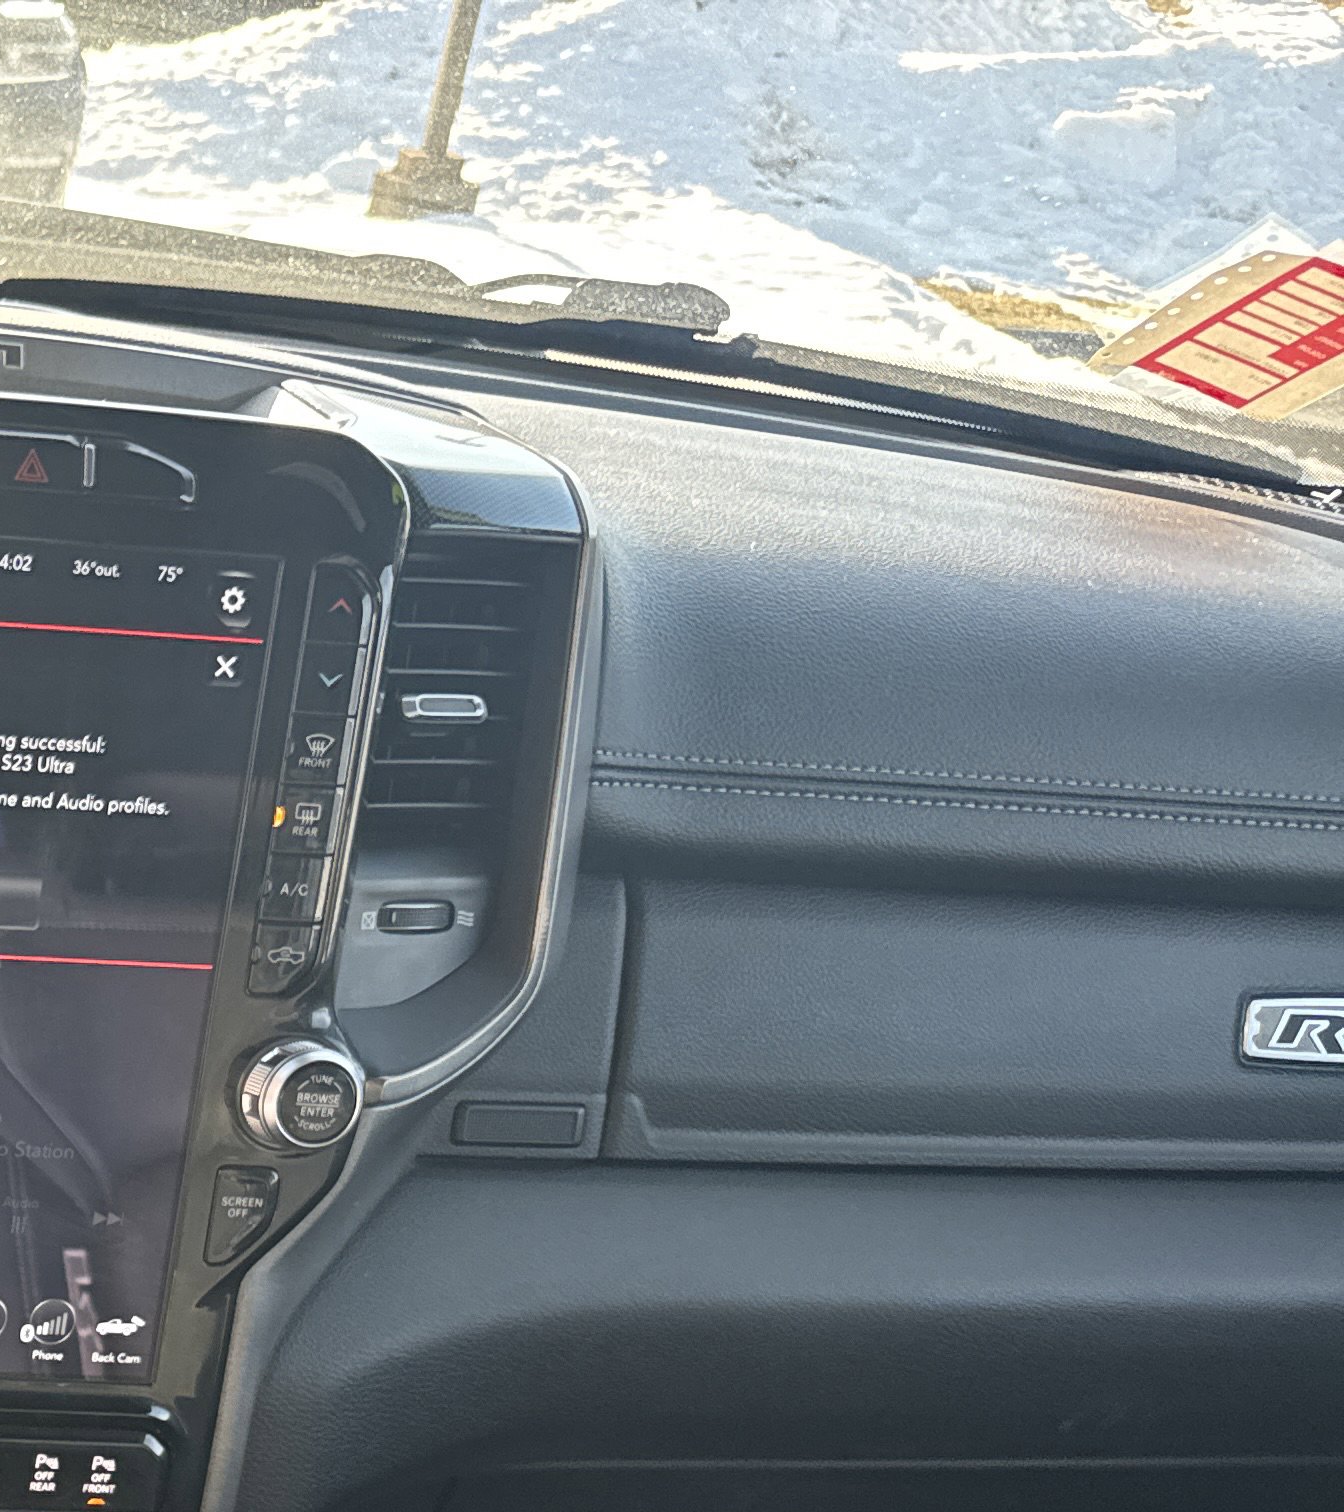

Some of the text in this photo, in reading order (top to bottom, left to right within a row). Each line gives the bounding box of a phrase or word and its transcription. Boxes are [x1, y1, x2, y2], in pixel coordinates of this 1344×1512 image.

[157, 565, 184, 583] 75°
[20, 735, 108, 755] successful:
[0, 754, 33, 773] S23
[37, 754, 76, 775] Ultra
[298, 757, 333, 769] FRONT
[21, 791, 53, 810] and
[56, 793, 105, 813] Audio
[107, 797, 171, 817] profiles.
[292, 826, 318, 838] REAR
[279, 882, 310, 897] A/C
[1267, 1008, 1344, 1058] R
[310, 1074, 334, 1086] TUNE
[297, 1093, 341, 1104] BROWSE
[300, 1106, 334, 1118] ENTER
[297, 1119, 332, 1132] SCROLL
[14, 1141, 75, 1161] Station
[3, 1196, 40, 1209] Audio
[221, 1196, 264, 1208] SCREEN
[227, 1209, 249, 1218] OFF
[31, 1349, 64, 1363] Phone
[91, 1351, 142, 1365] Back Cam
[34, 1471, 56, 1481] OFF
[90, 1473, 112, 1483] OFF
[29, 1481, 56, 1492] REAR
[82, 1483, 116, 1494] FRONT
